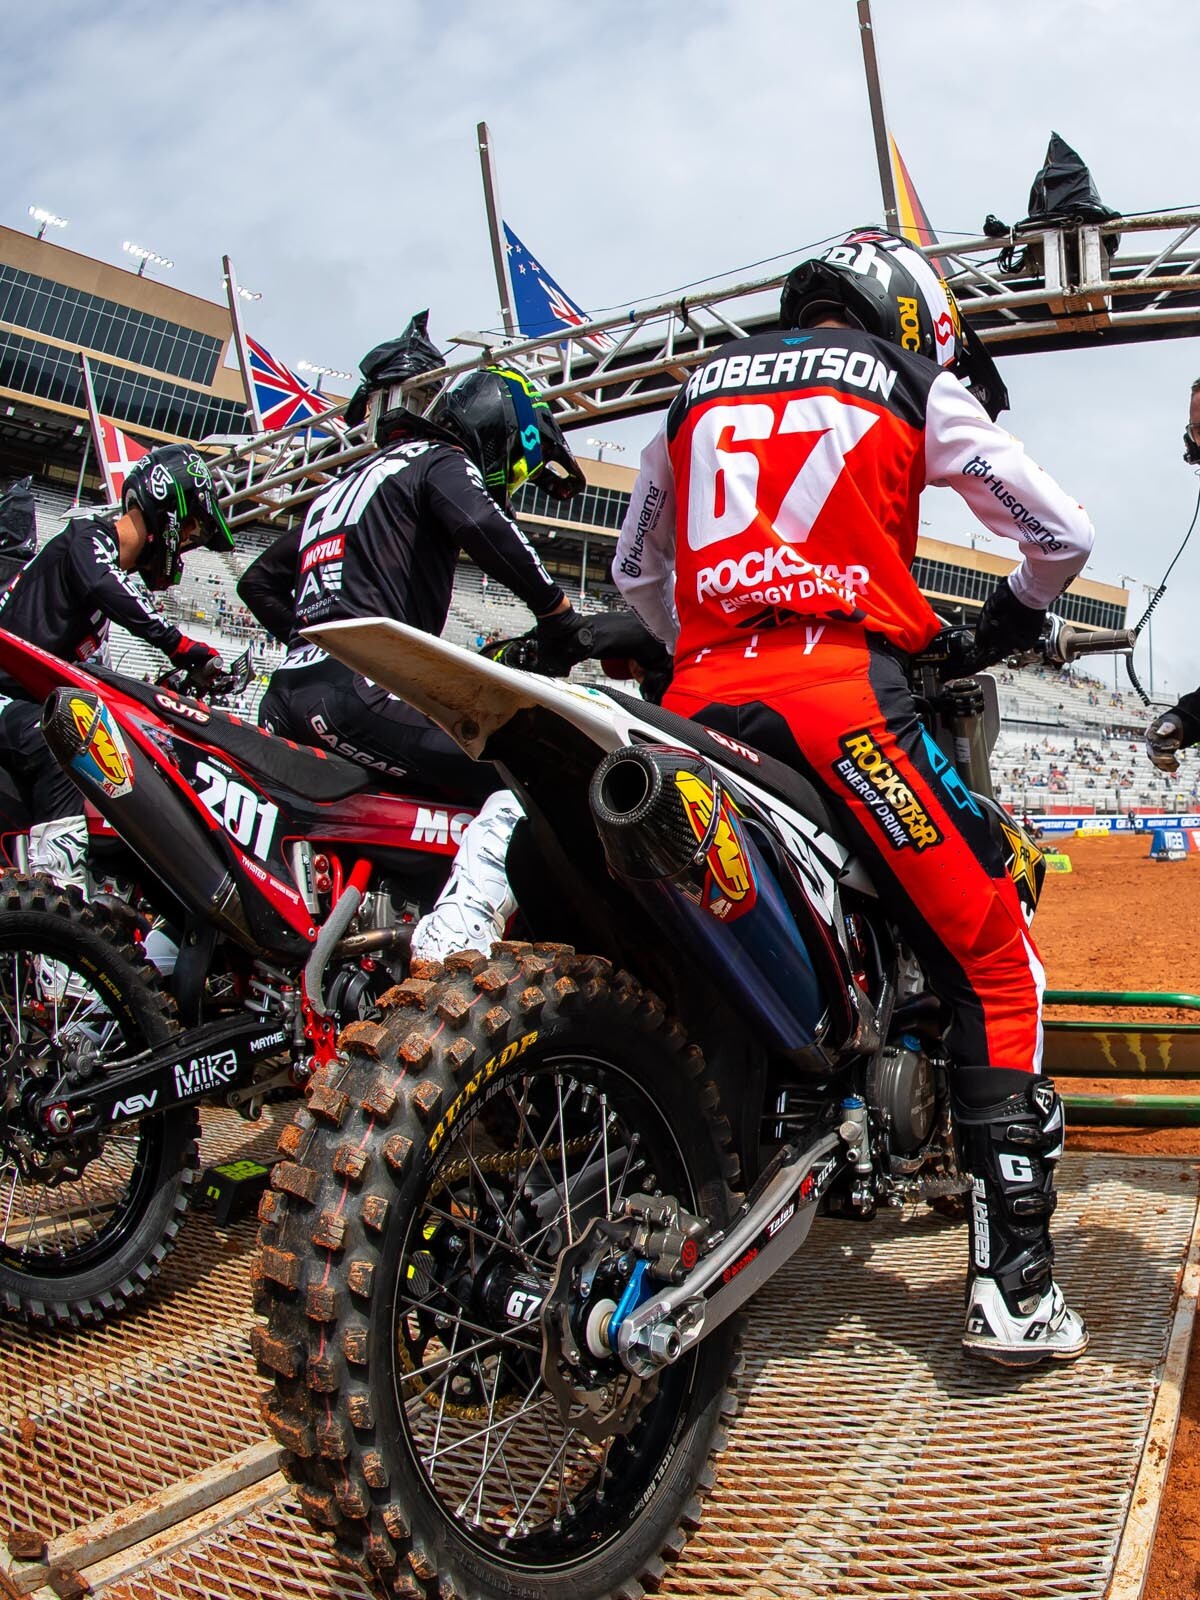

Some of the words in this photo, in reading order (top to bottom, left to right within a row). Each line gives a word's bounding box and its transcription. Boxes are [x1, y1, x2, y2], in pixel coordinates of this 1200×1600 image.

[685, 347, 898, 401] ROBERTSON
[687, 395, 880, 551] 67
[629, 485, 661, 563] Husqvarna
[984, 473, 1063, 553] Husqvarna
[304, 538, 343, 569] MOTUL
[155, 694, 210, 723] GUTS
[310, 714, 407, 777] GASGAS
[705, 728, 760, 763] GUTS
[195, 761, 280, 863] 201
[837, 759, 884, 806] ENERGY
[875, 805, 910, 847] DRINK
[845, 734, 938, 848] ROCKSTAR
[1116, 819, 1144, 829] GECO
[241, 855, 268, 882] TWISTED
[183, 1079, 222, 1097] Metals
[507, 1290, 543, 1321] 67
